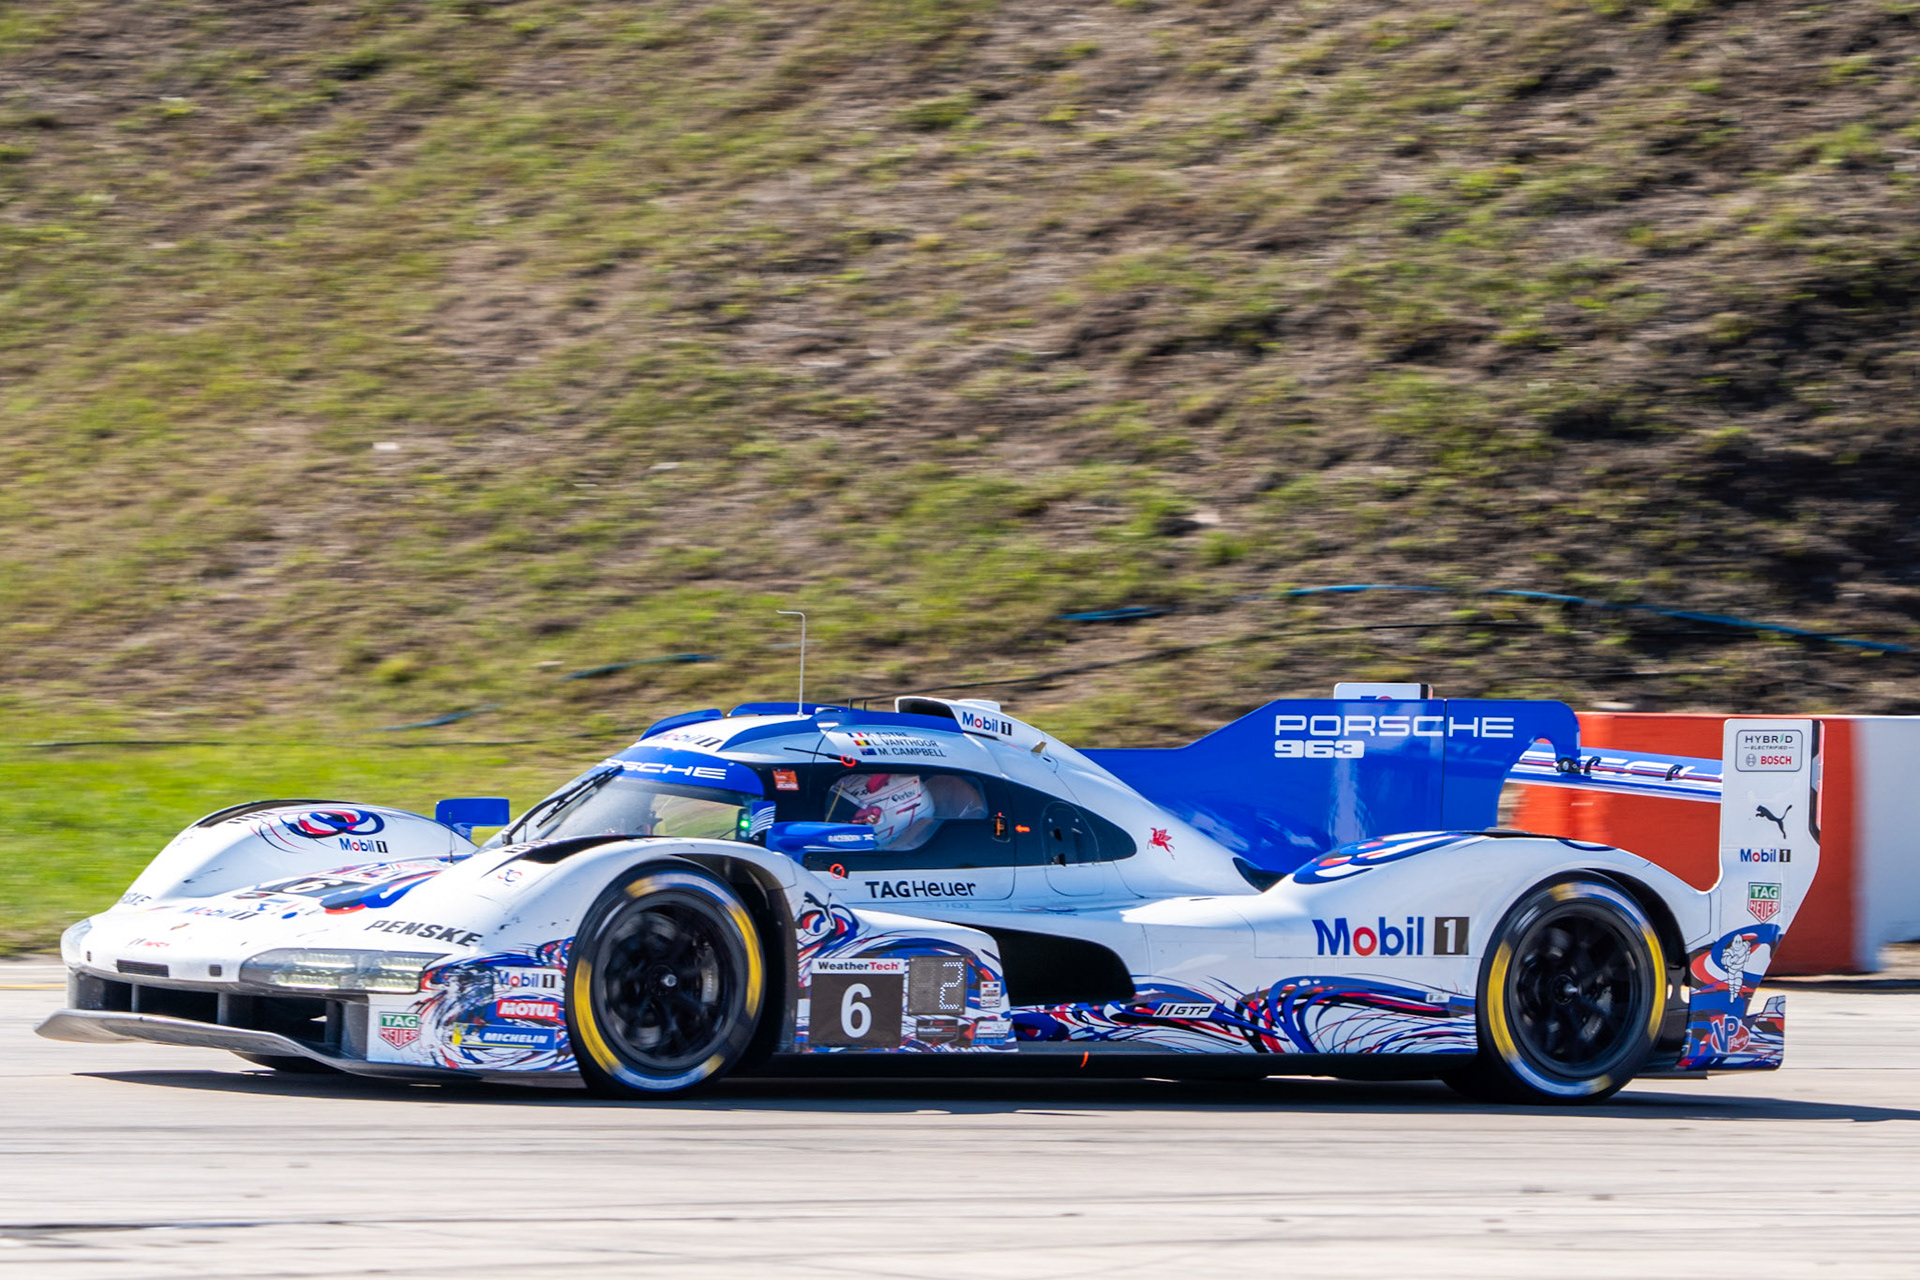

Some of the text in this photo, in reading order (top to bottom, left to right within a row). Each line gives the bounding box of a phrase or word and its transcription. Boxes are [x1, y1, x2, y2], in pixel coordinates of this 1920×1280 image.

[962, 711, 999, 733] Mobil
[1274, 715, 1515, 738] PORSCHE
[881, 739, 939, 748] VANTHOOR
[1274, 740, 1364, 758] 963
[877, 748, 947, 757] M. CAMPBELL
[1760, 756, 1792, 765] BOSCH
[339, 837, 375, 852] Mobil
[1740, 849, 1776, 862] Mobil
[1753, 886, 1778, 898] TAG
[1750, 901, 1779, 917] HEUER
[364, 920, 484, 946] PENSKE
[1312, 916, 1425, 956] Mobil
[818, 961, 899, 971] WeatherTech
[500, 972, 539, 987] Mobil
[939, 961, 964, 1010] 2
[499, 1002, 556, 1016] MOTUL
[841, 983, 872, 1038] 6
[1174, 1006, 1211, 1015] GTP
[383, 1015, 418, 1027] TAG
[381, 1029, 418, 1045] HEUER
[482, 1032, 549, 1043] MICHELIN
[1713, 1017, 1740, 1053] VP
